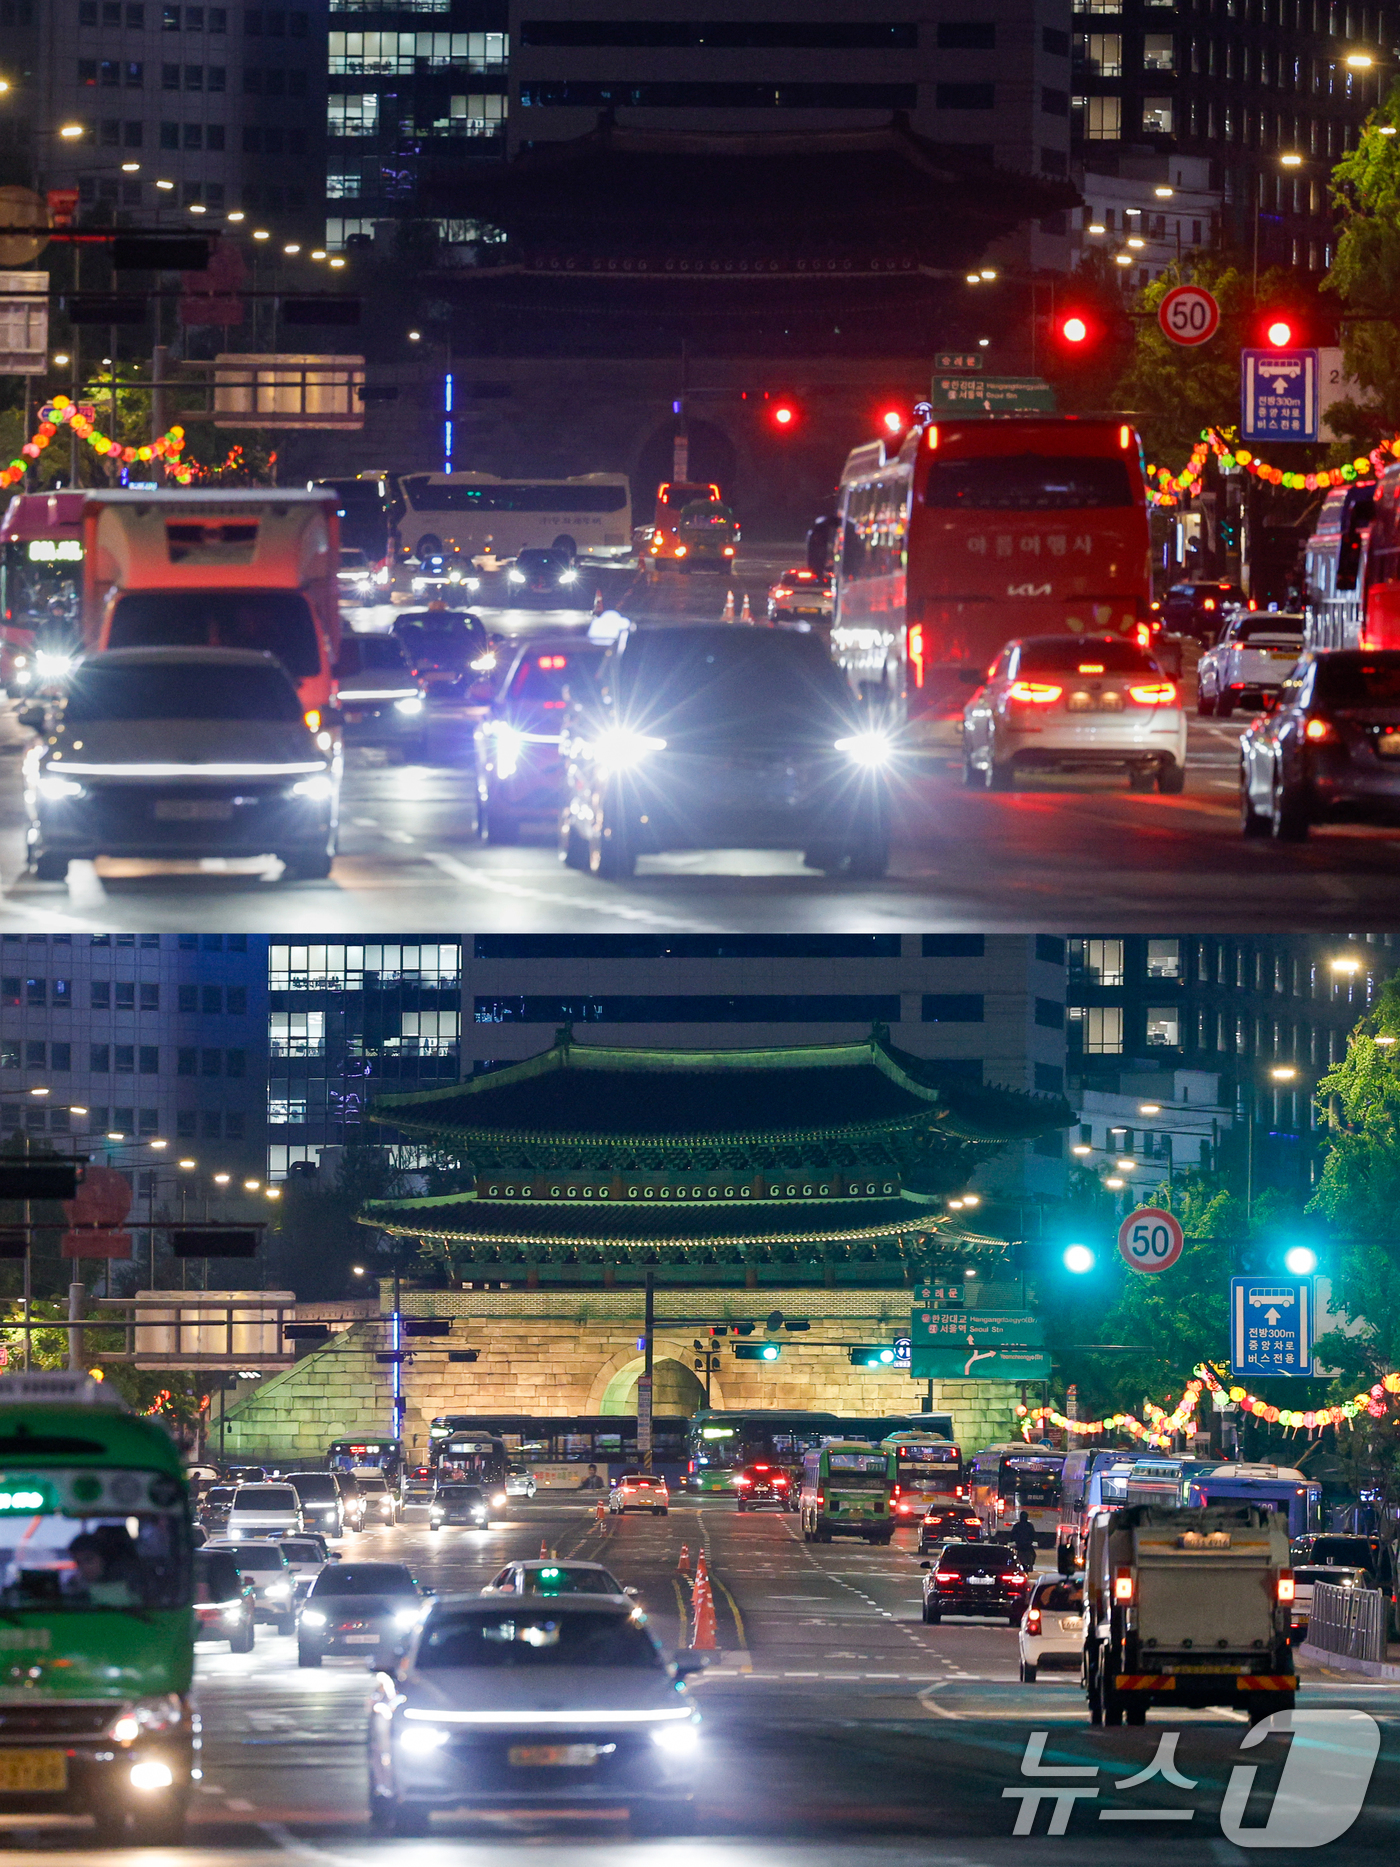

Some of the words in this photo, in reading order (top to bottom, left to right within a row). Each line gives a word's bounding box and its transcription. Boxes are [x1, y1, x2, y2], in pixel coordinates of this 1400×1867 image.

[1172, 301, 1206, 331] 50
[1132, 1225, 1169, 1257] 50
[921, 1288, 958, 1298] 숭례문
[932, 1314, 967, 1324] 한강대교
[940, 1324, 967, 1333] 서울역
[970, 1325, 989, 1333] Seoul
[991, 1325, 1004, 1333] Stn
[1248, 1327, 1295, 1338] 전방300m
[1248, 1340, 1295, 1351] 중앙차로
[1248, 1353, 1295, 1364] 버스전용
